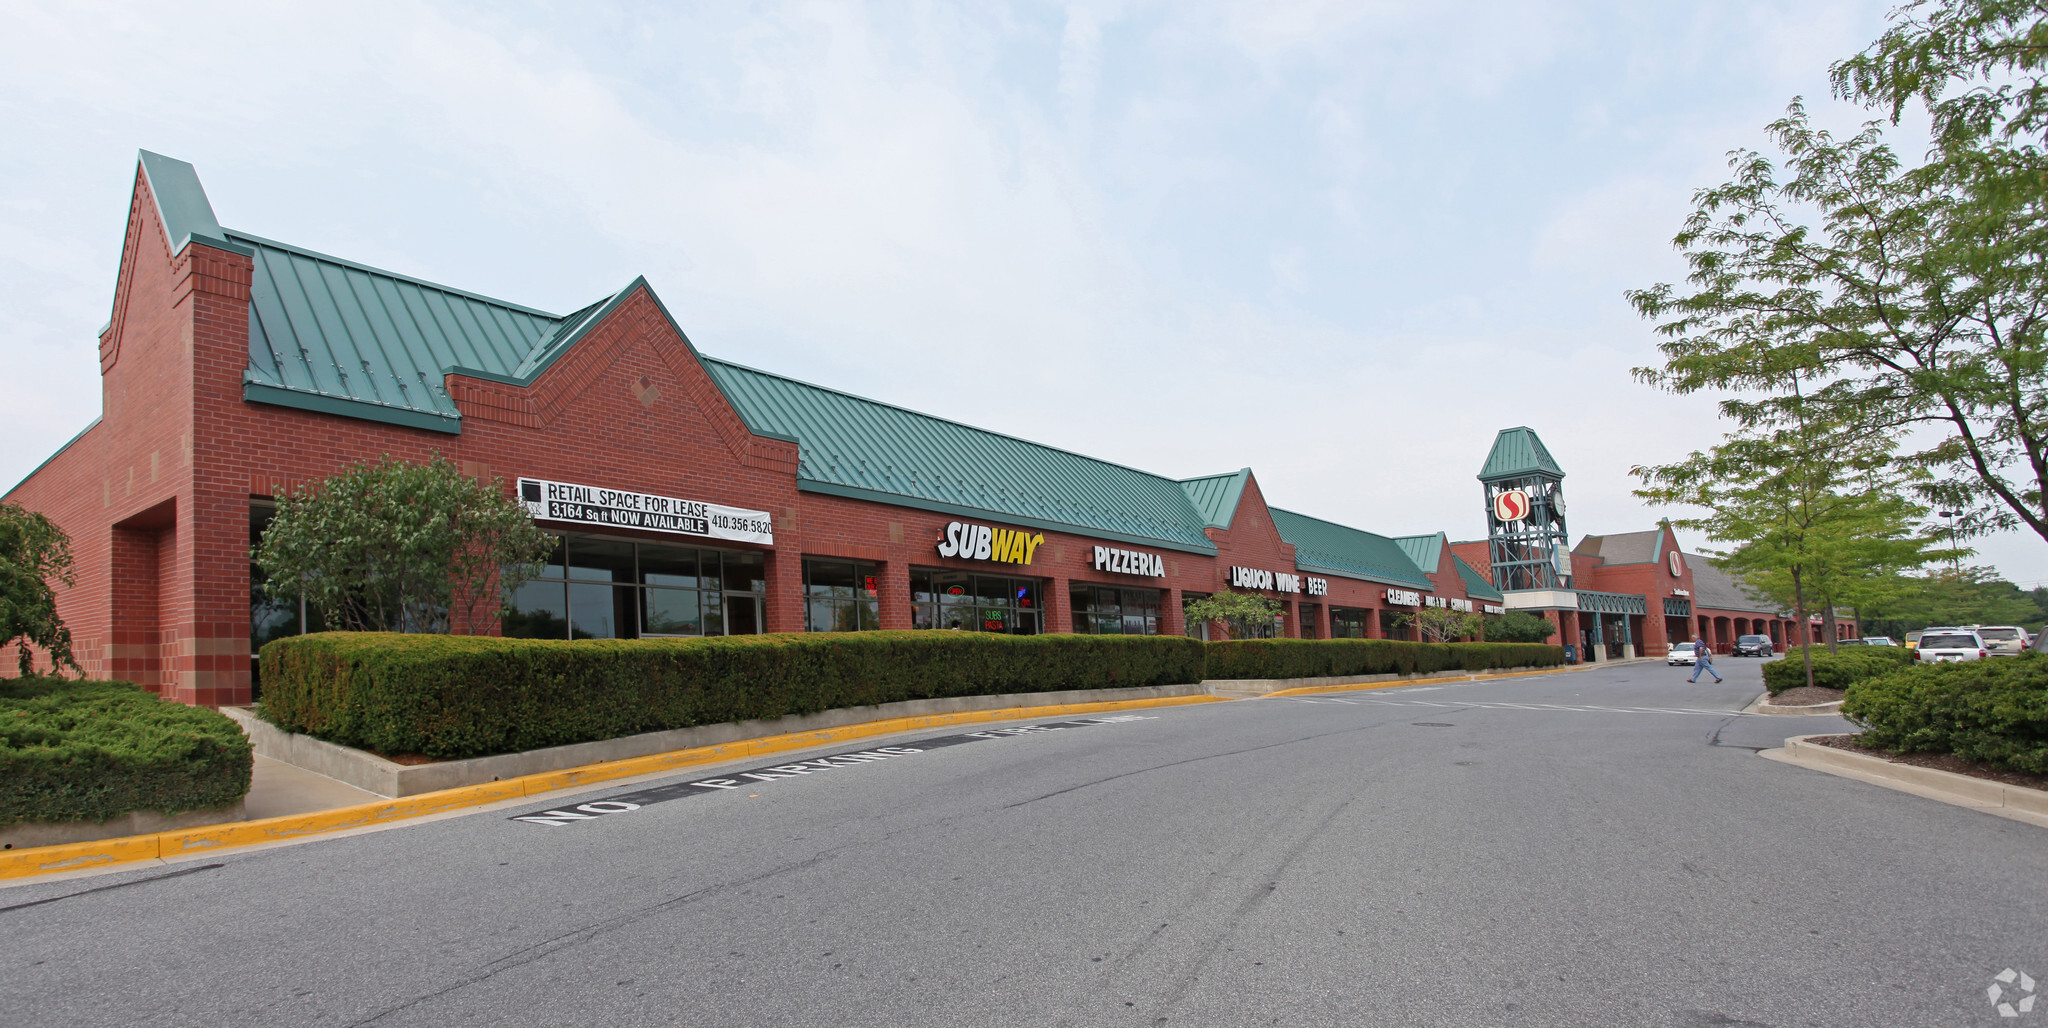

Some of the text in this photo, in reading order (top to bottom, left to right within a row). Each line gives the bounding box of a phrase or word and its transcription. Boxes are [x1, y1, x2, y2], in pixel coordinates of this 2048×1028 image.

[548, 483, 708, 519] RETAIL SPACE FOR LEASE
[552, 502, 583, 519] 3,164
[586, 509, 599, 522] Sq
[601, 511, 608, 521] ft
[611, 510, 640, 526] NOW
[643, 514, 704, 533] AVAILABLE
[711, 515, 772, 535] 410.356.5820
[938, 521, 1045, 566] SUBWAY
[1094, 546, 1166, 578] PIZZERIA
[1232, 566, 1328, 596] LIQUOR WINE BEER
[1387, 588, 1420, 607] CLEANERS
[985, 610, 1002, 620] SUBS
[985, 620, 1003, 630] PASTA
[513, 801, 641, 826] NO
[690, 747, 924, 790] PARKING
